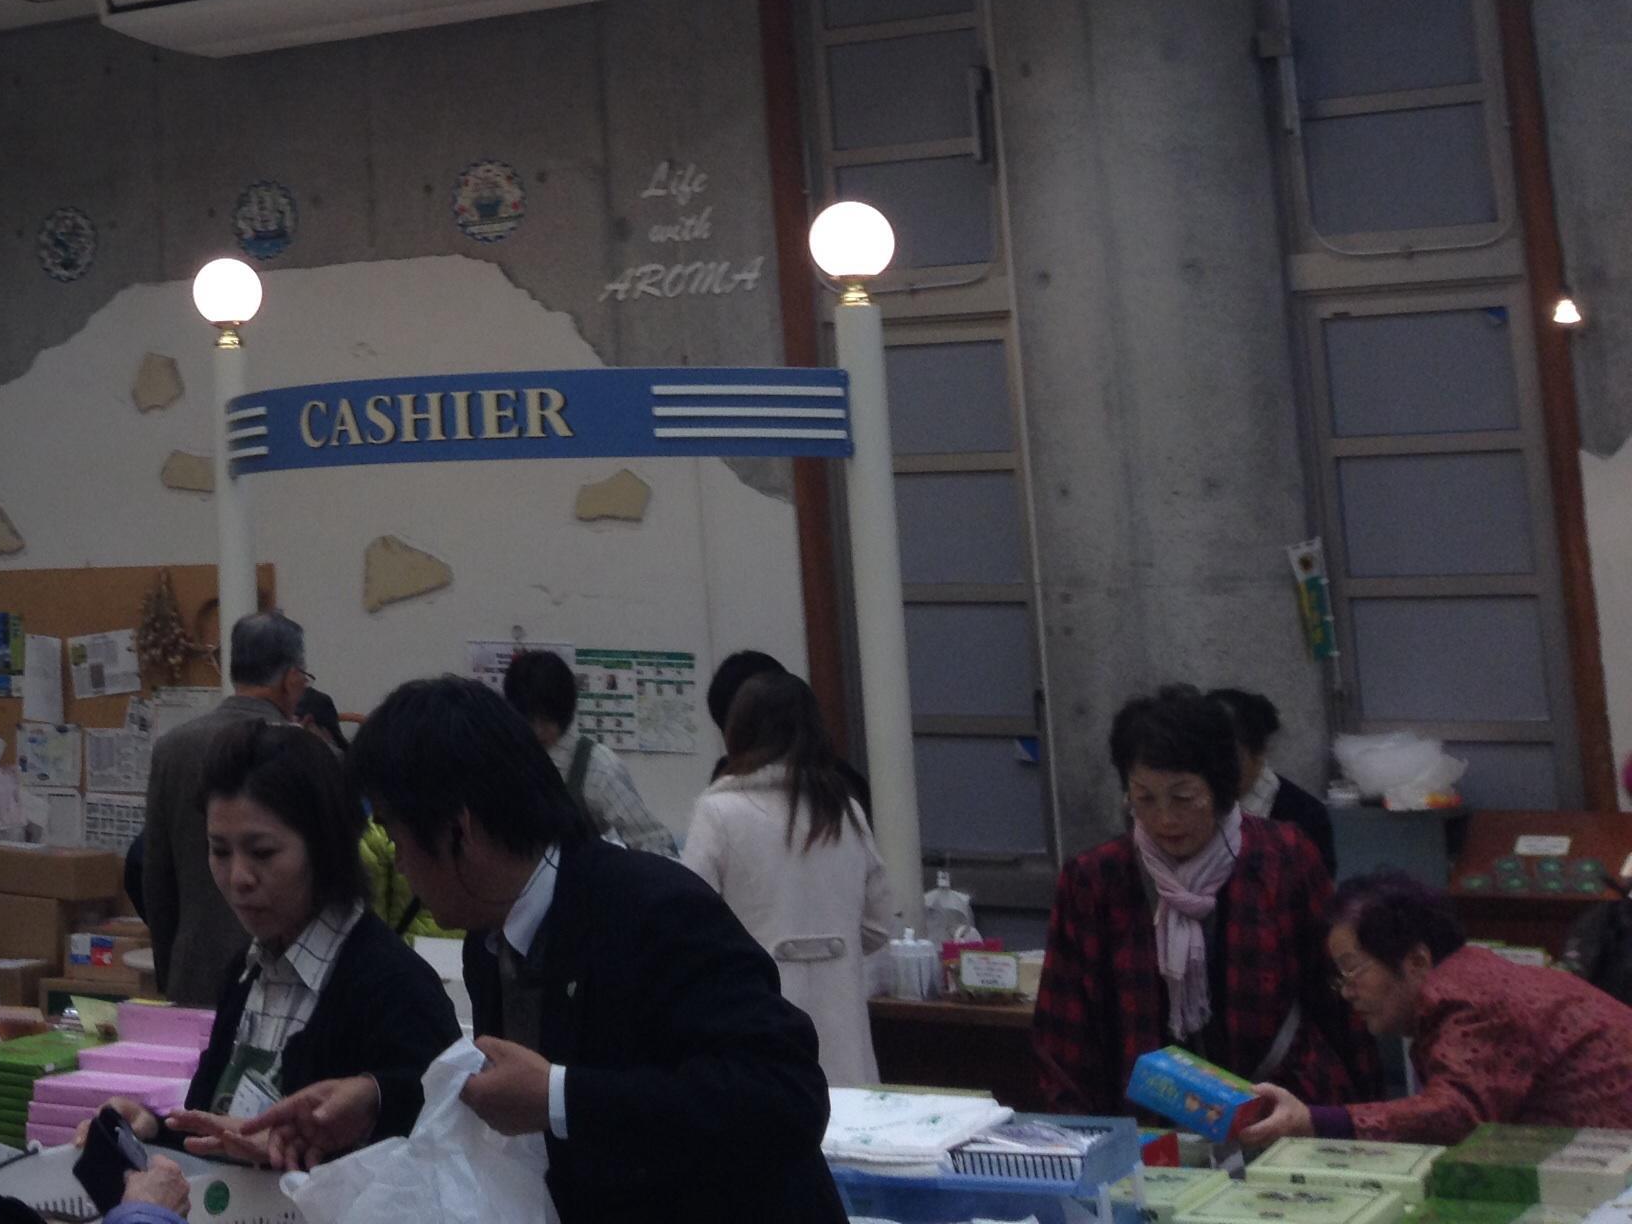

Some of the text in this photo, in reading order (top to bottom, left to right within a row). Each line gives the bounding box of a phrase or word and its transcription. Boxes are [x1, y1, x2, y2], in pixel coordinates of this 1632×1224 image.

[639, 161, 709, 206] Life
[647, 206, 713, 242] with
[597, 255, 765, 302] AROMA
[299, 387, 575, 449] CASHIER
